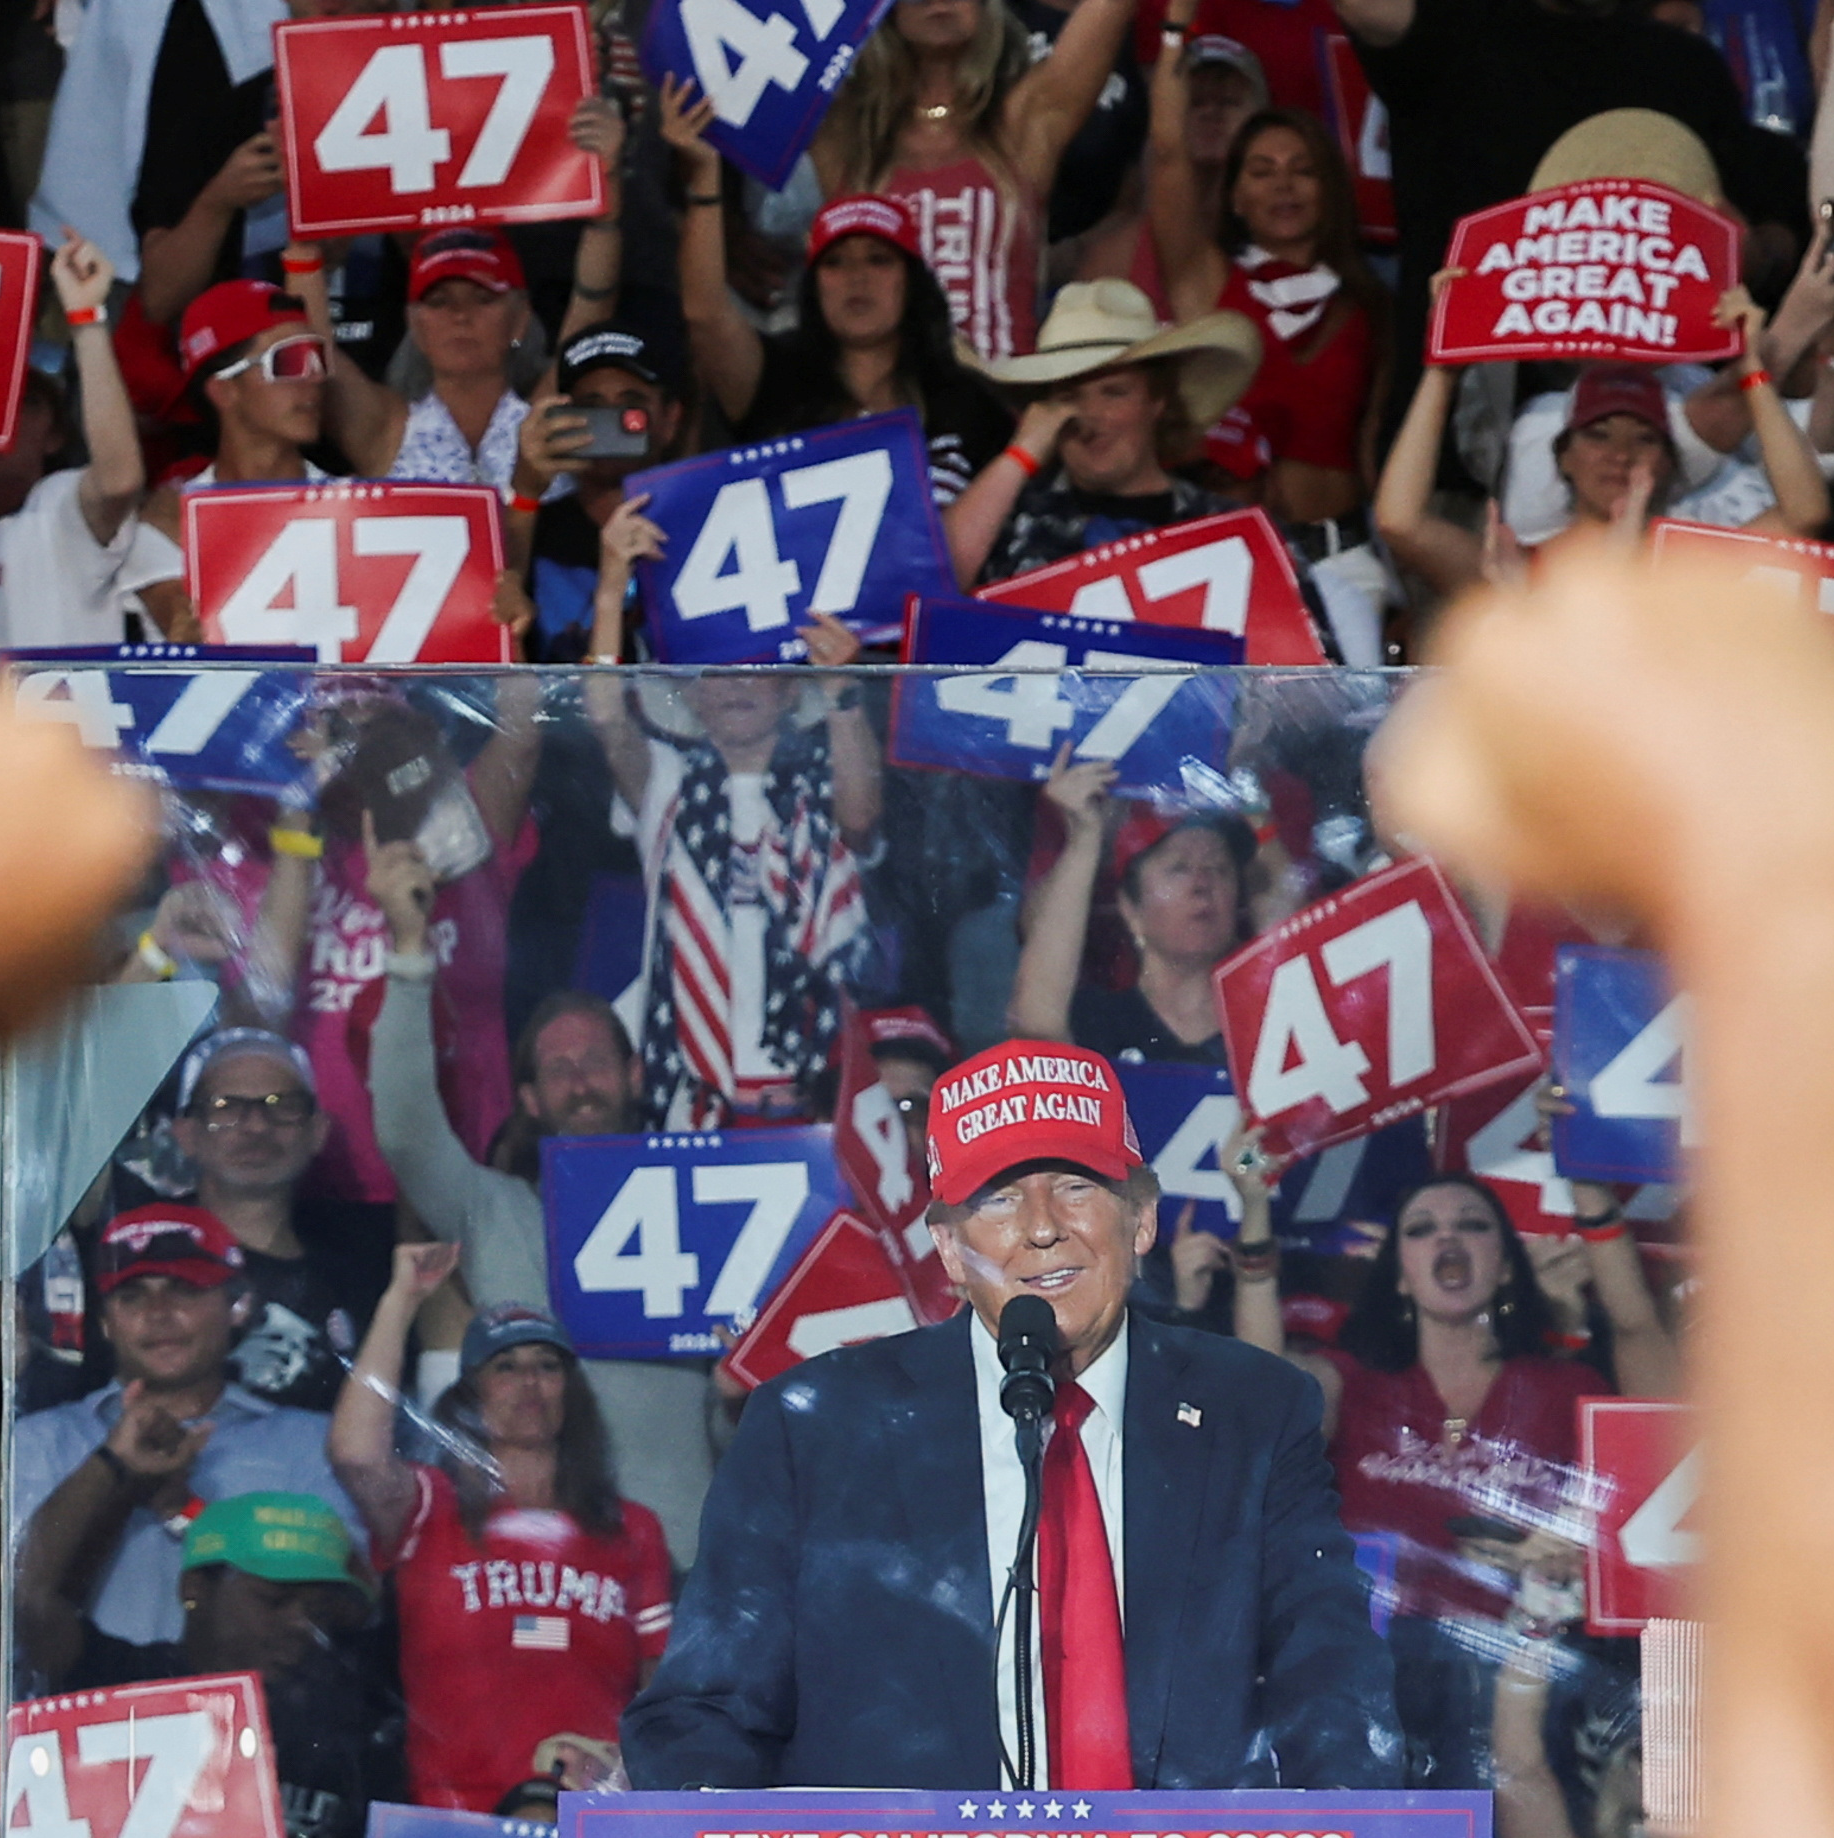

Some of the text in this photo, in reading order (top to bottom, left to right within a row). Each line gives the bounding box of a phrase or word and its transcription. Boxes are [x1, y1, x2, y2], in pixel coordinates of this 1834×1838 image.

[685, 0, 848, 128] 4
[314, 35, 555, 195] 47
[422, 204, 476, 224] 2024
[1524, 195, 1672, 235] MAKE
[1476, 231, 1710, 281] AMERICA
[1502, 264, 1679, 309] GREAT
[1491, 300, 1678, 347] AGAIN!
[672, 450, 893, 633] 47
[219, 516, 471, 663] 47
[779, 637, 813, 662] 20
[18, 671, 262, 755] 47
[938, 641, 1192, 759] 47
[1249, 900, 1437, 1119] 47
[940, 1055, 1111, 1114] MAKE AMERICA
[1591, 990, 1697, 1148] 4
[956, 1092, 1102, 1145] GREAT AGAIN
[1466, 1077, 1576, 1216] 4
[573, 1161, 811, 1319] 47
[670, 1333, 723, 1351] 2024
[450, 1559, 628, 1623] TRUMP
